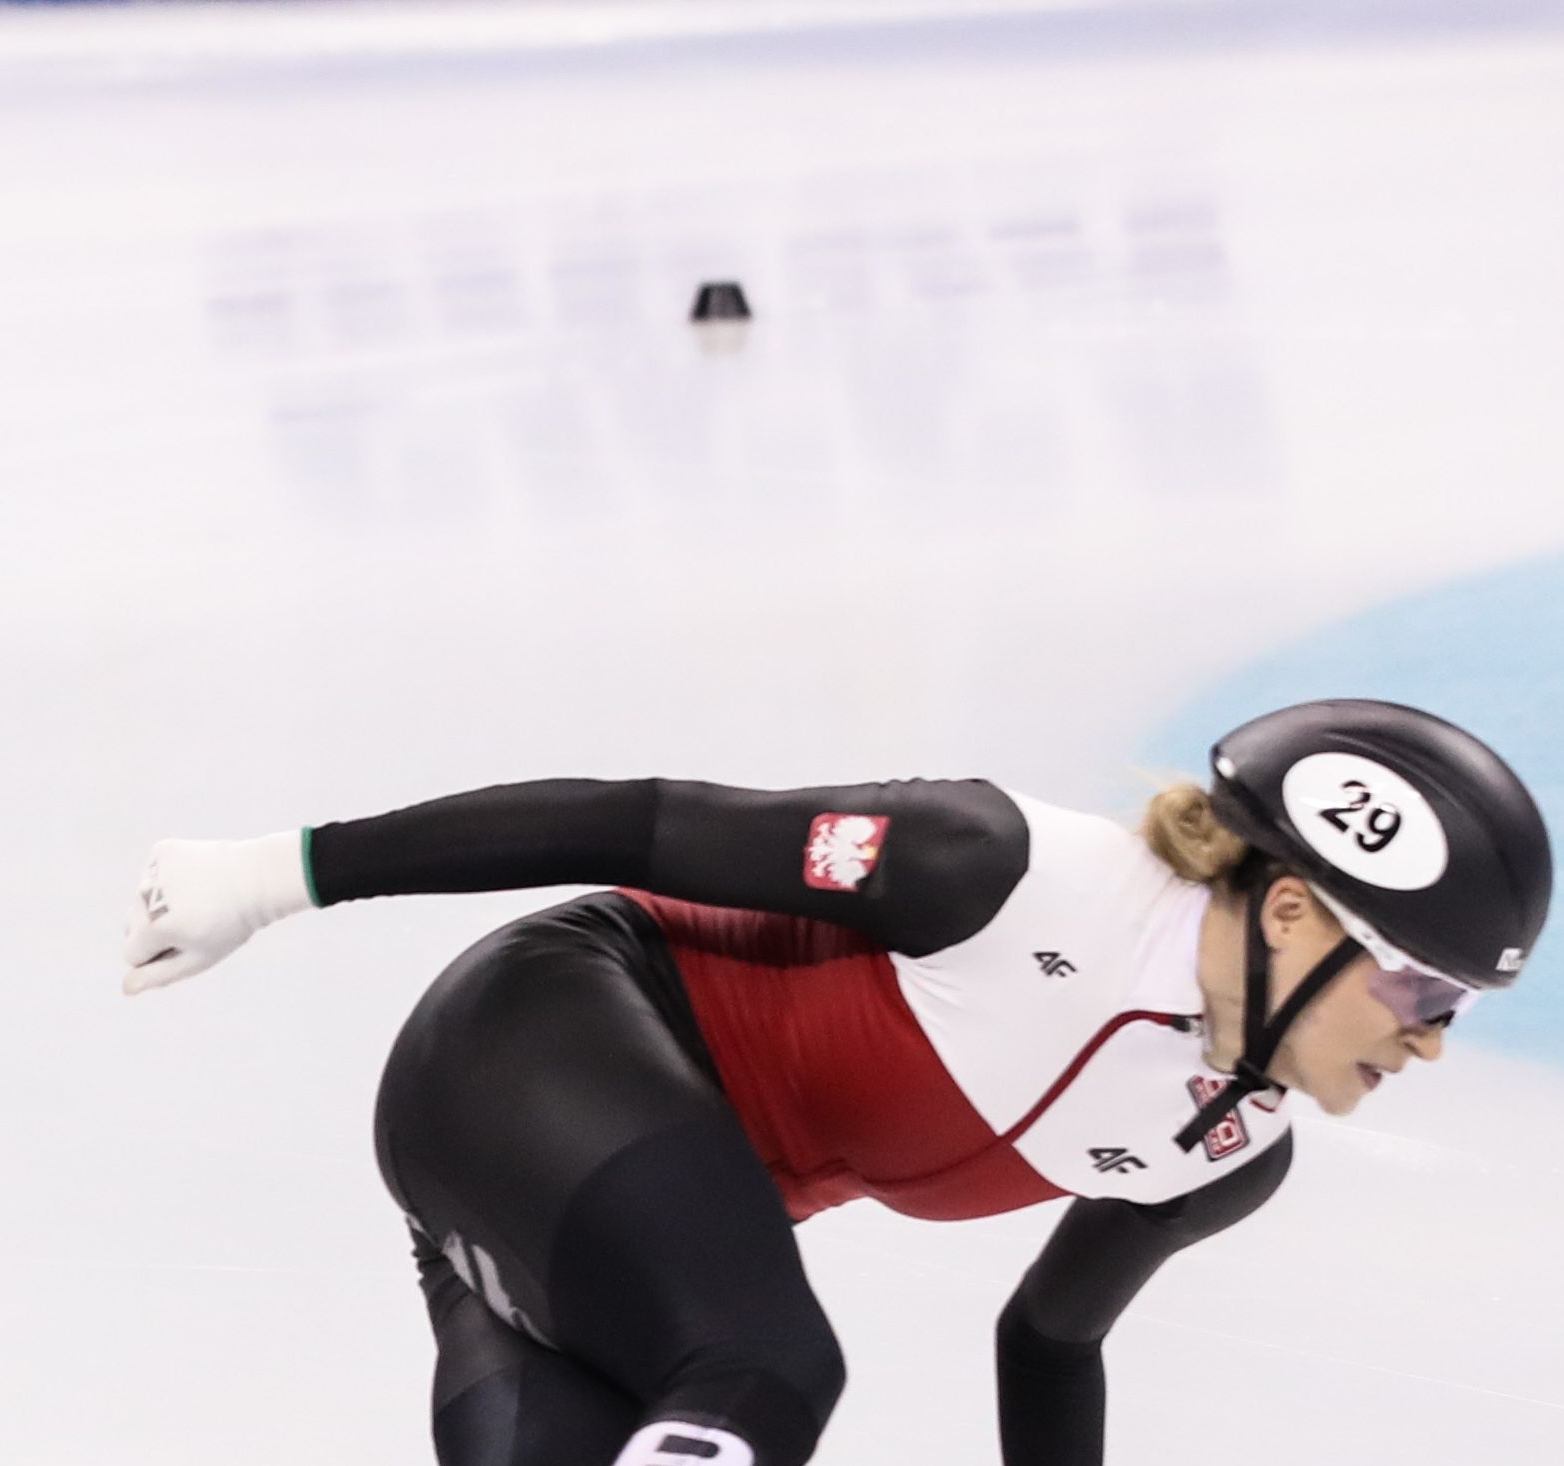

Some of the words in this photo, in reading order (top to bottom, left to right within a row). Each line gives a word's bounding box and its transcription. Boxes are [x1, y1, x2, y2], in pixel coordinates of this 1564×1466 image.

[1319, 780, 1402, 853] 29
[1032, 951, 1077, 978] 4F
[1087, 1147, 1149, 1174] 4F
